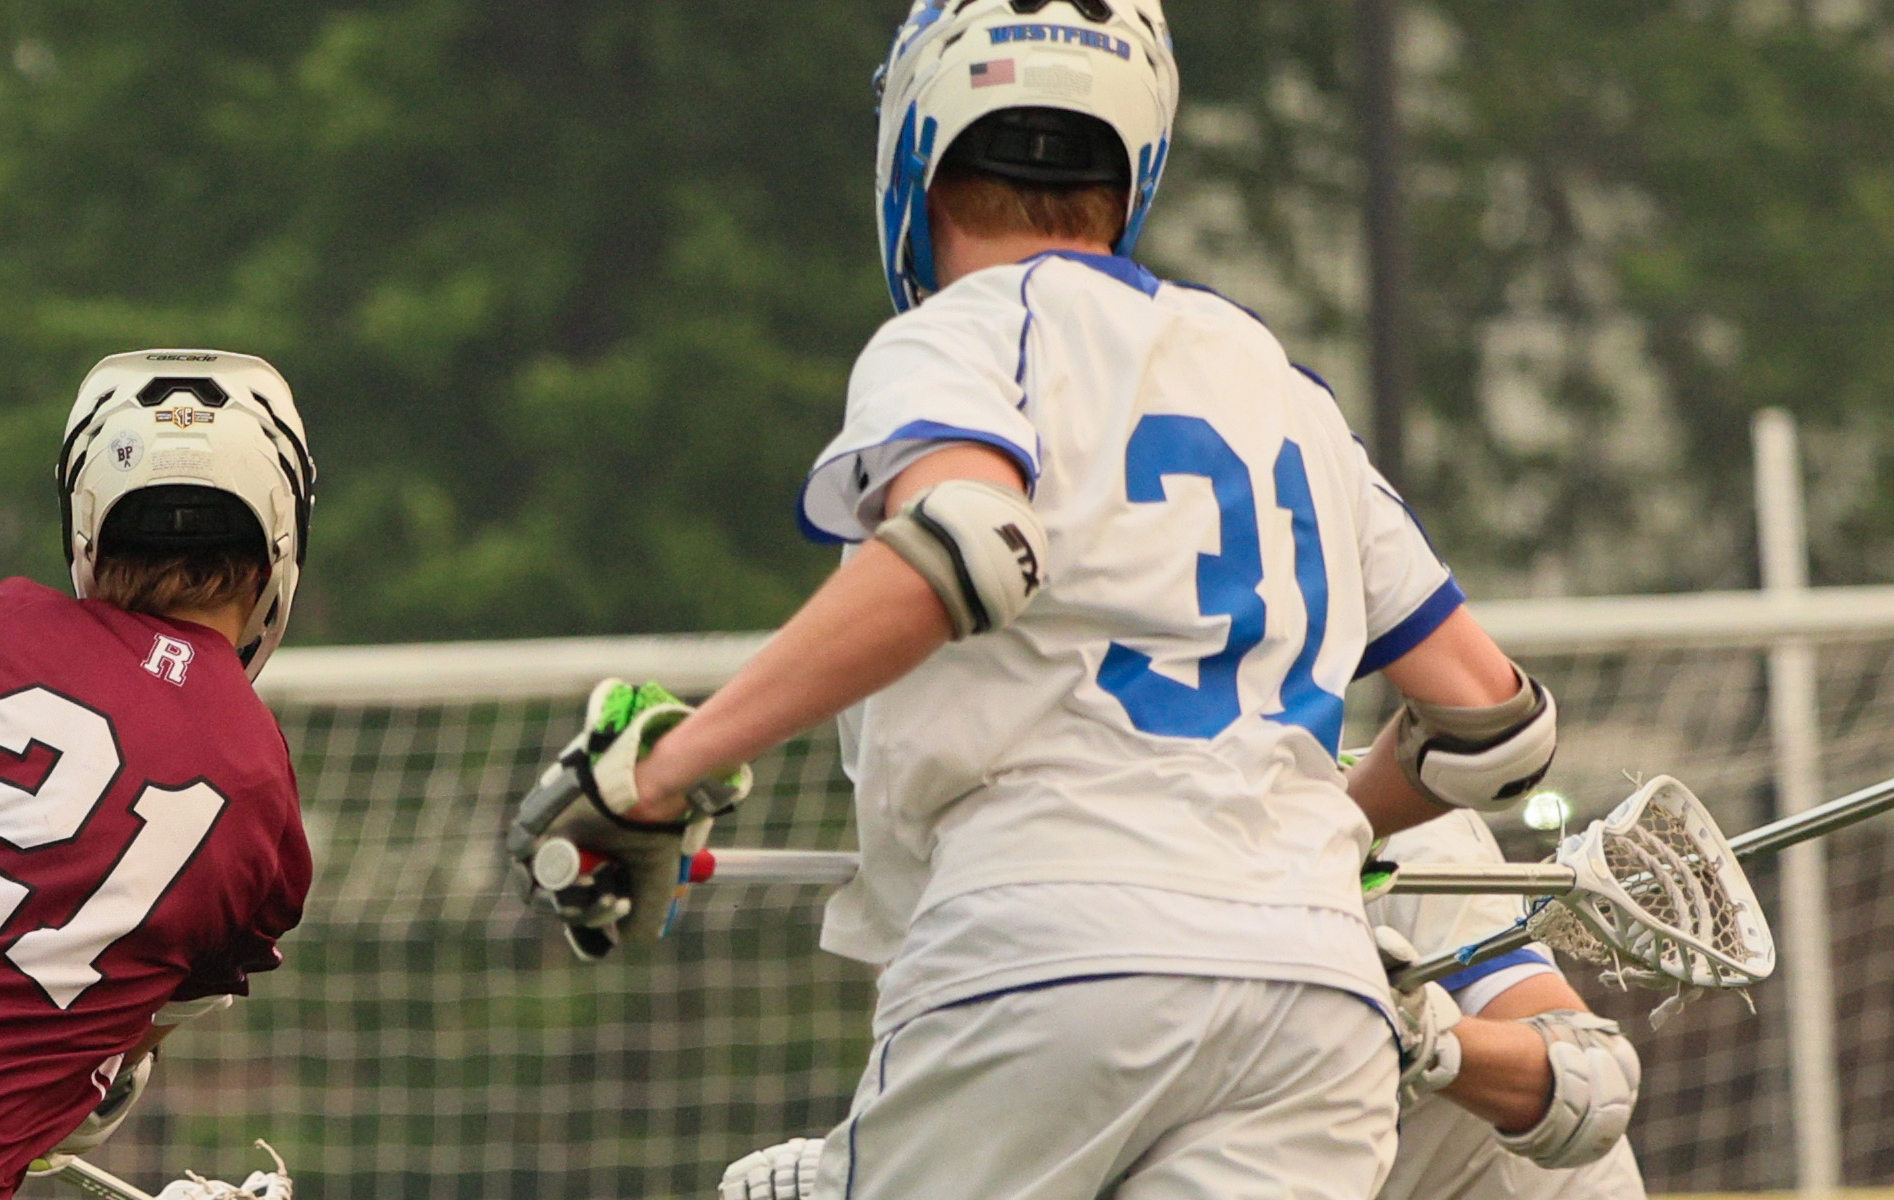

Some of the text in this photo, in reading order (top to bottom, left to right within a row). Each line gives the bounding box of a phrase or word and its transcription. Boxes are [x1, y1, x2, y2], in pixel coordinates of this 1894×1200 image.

[986, 24, 1131, 61] WESTFIELD
[993, 522, 1040, 597] STX
[1097, 414, 1344, 763] 31
[140, 632, 195, 688] R
